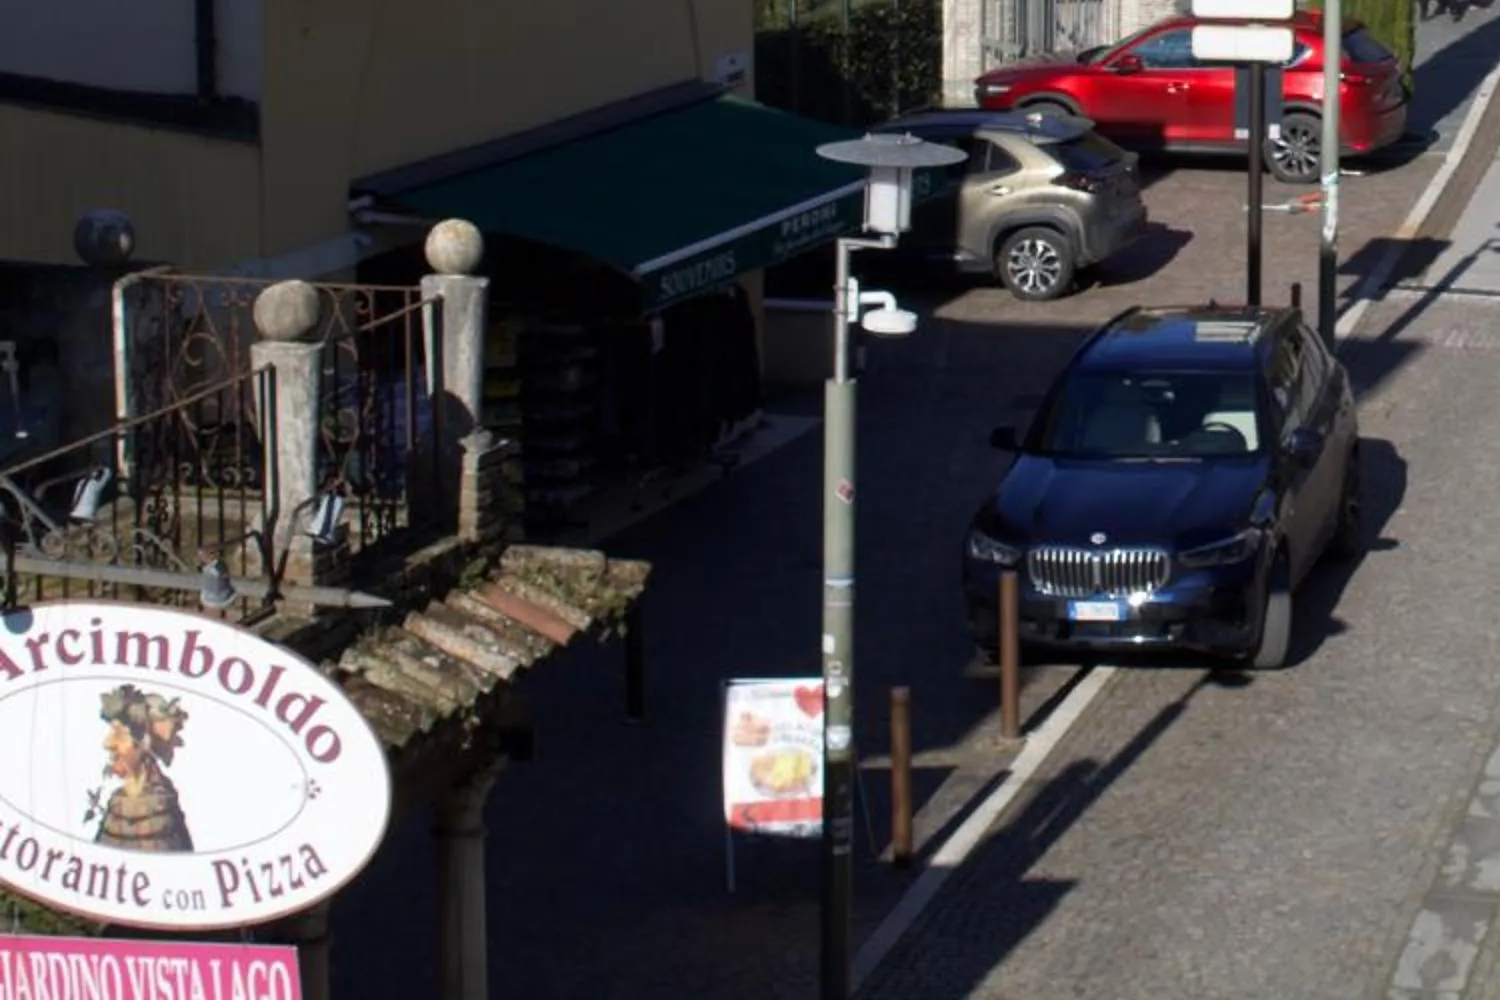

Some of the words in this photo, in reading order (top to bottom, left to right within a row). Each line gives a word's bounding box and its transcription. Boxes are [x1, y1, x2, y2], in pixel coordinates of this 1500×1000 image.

[0, 820, 151, 908] torante
[162, 888, 206, 911] con
[211, 842, 328, 908] Pizza
[0, 951, 122, 1000] IARDINO
[125, 956, 206, 1000] VISTA
